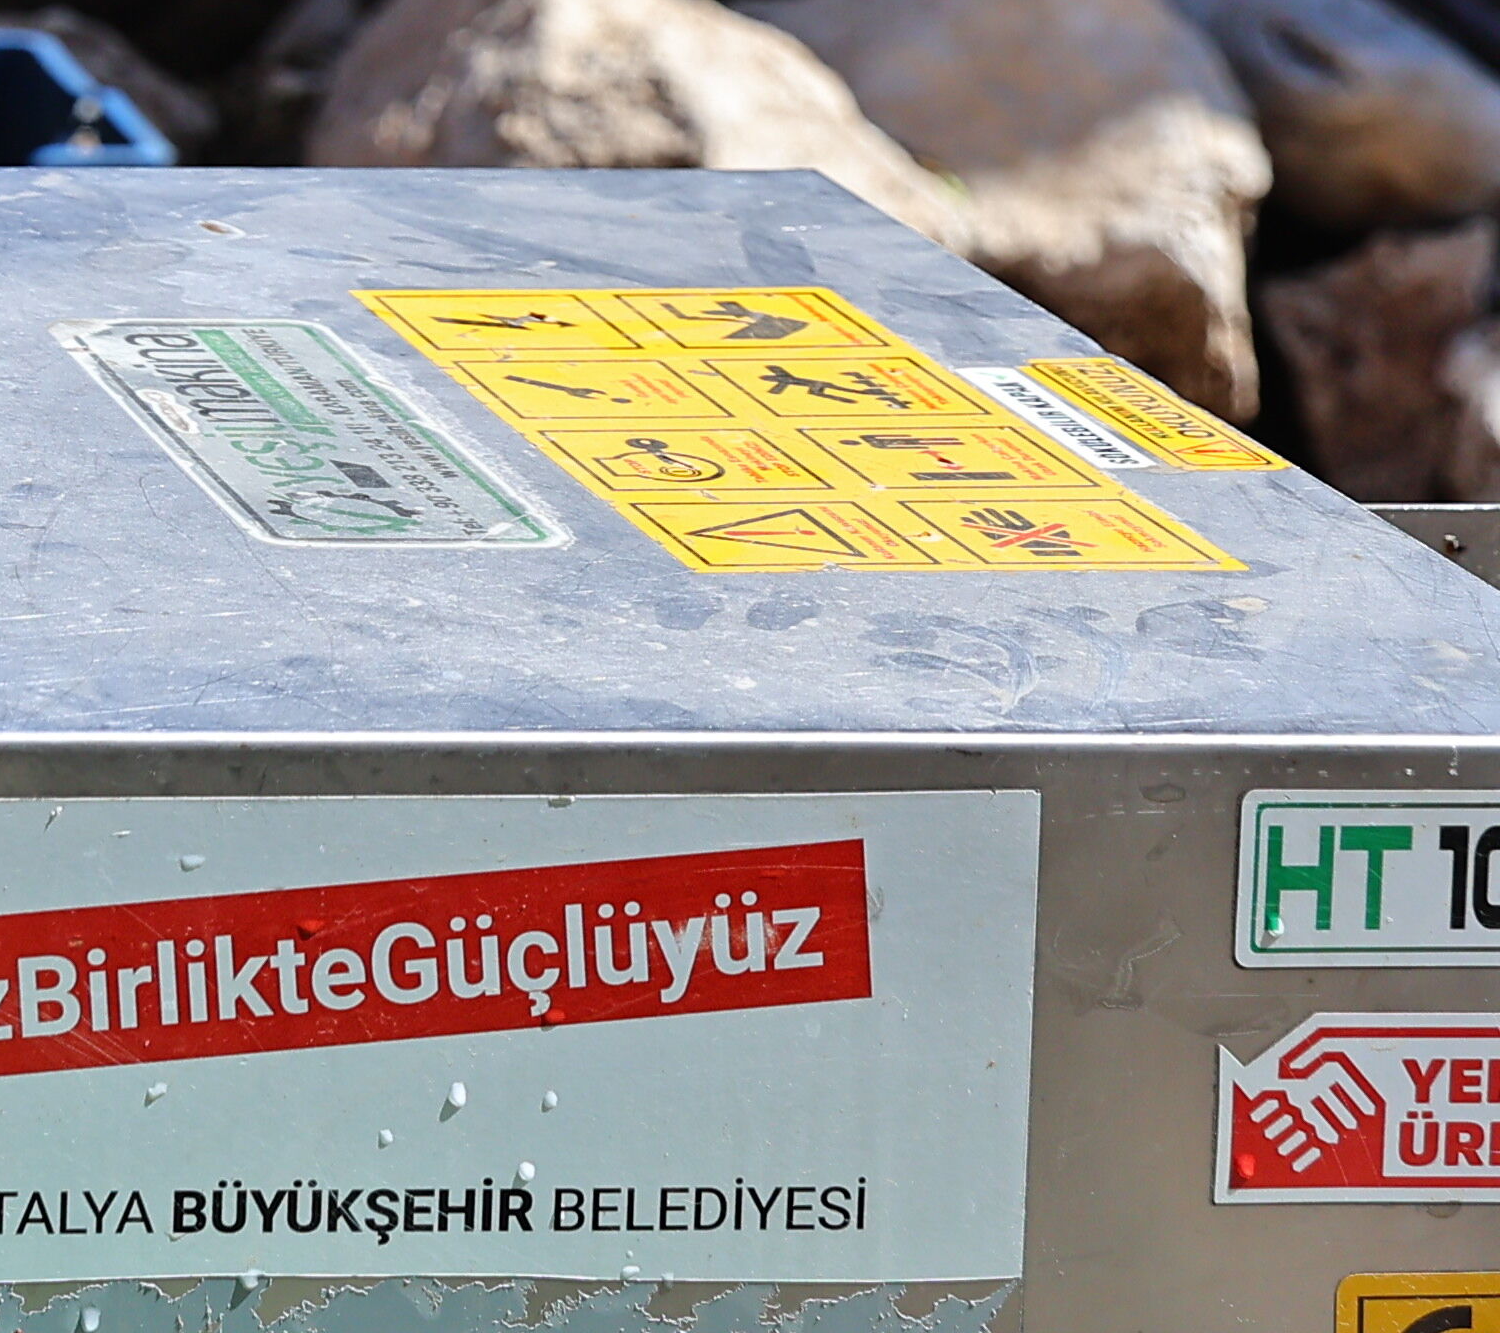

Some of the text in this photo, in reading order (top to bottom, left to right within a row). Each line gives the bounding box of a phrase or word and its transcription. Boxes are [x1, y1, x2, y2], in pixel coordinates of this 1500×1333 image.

[1263, 825, 1414, 931] HT
[172, 1177, 534, 1245] BÜYÜKŞEHİR
[552, 1176, 867, 1232] BELEDİYESİ
